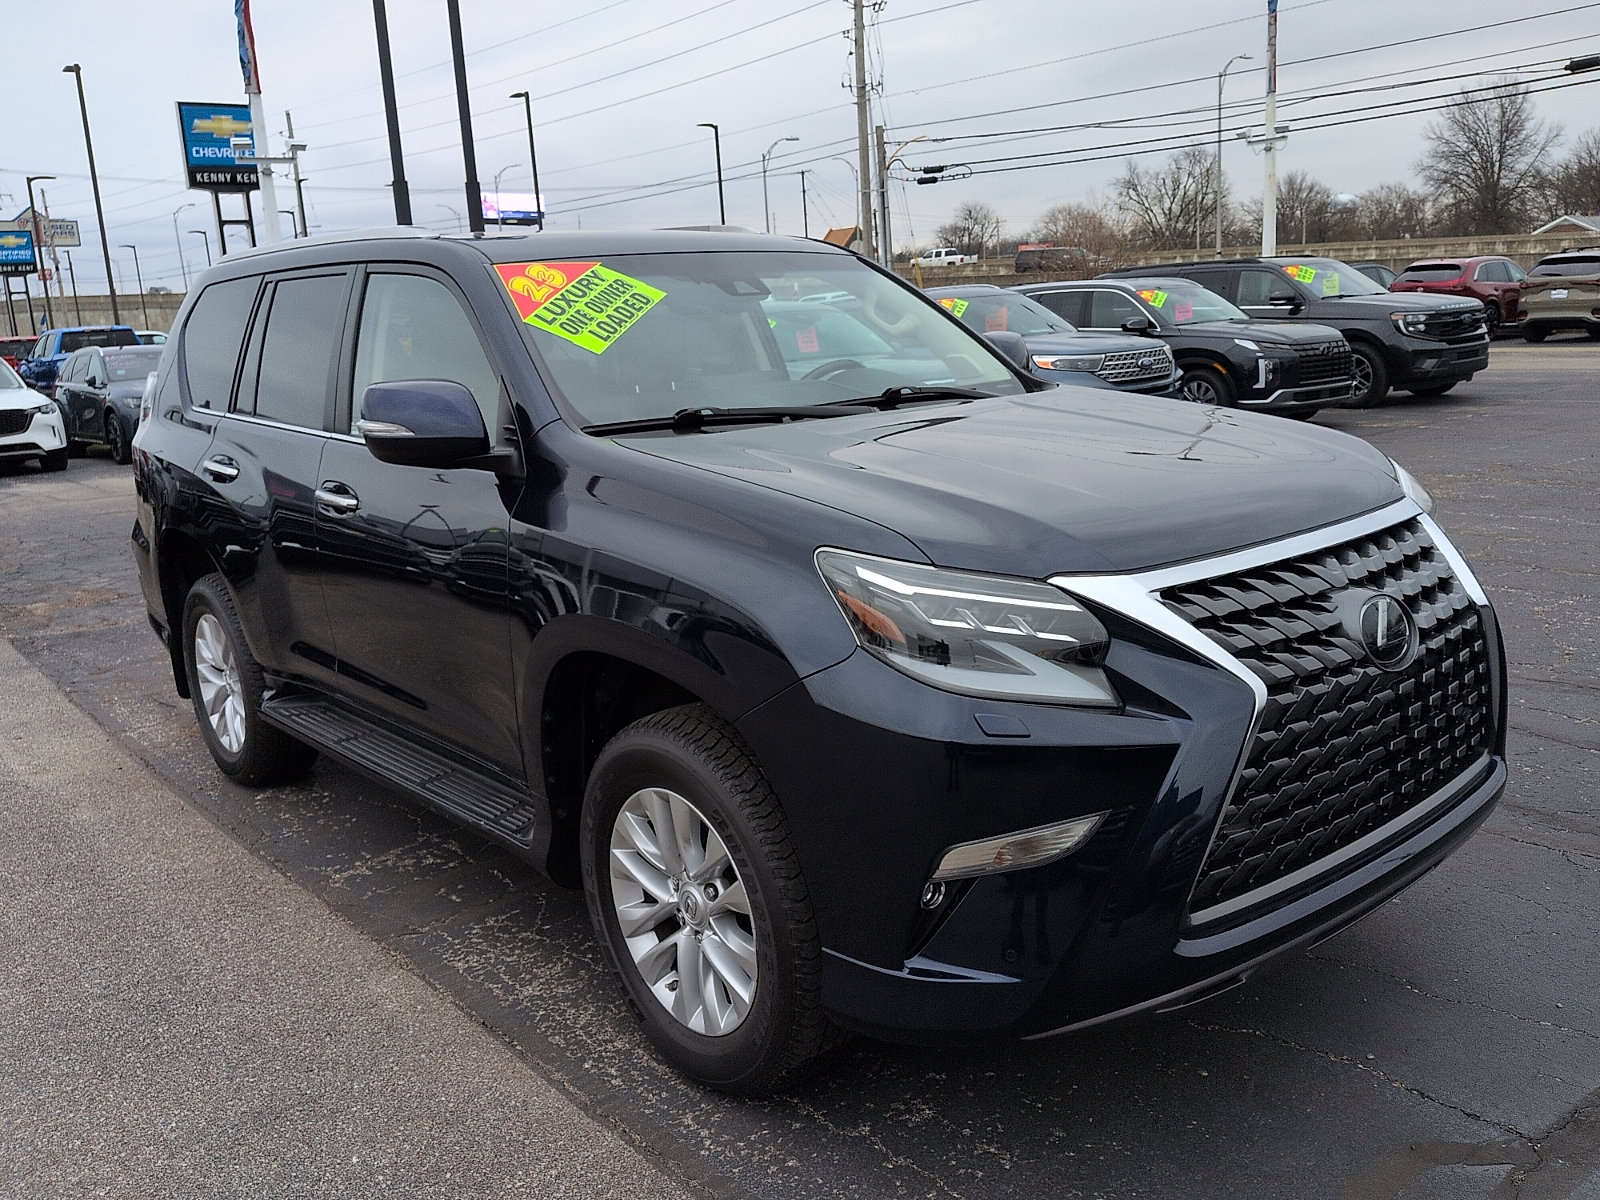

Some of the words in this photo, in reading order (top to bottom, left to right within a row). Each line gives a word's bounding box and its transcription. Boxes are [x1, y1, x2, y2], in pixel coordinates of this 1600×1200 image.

[193, 147, 256, 158] CHEVROLE
[196, 172, 232, 183] KENNY
[236, 173, 260, 183] KEN
[508, 264, 567, 302] 23
[534, 269, 608, 326] LUXURY
[558, 309, 598, 336] ONE
[583, 278, 637, 315] OWNER
[588, 291, 655, 343] LOADED
